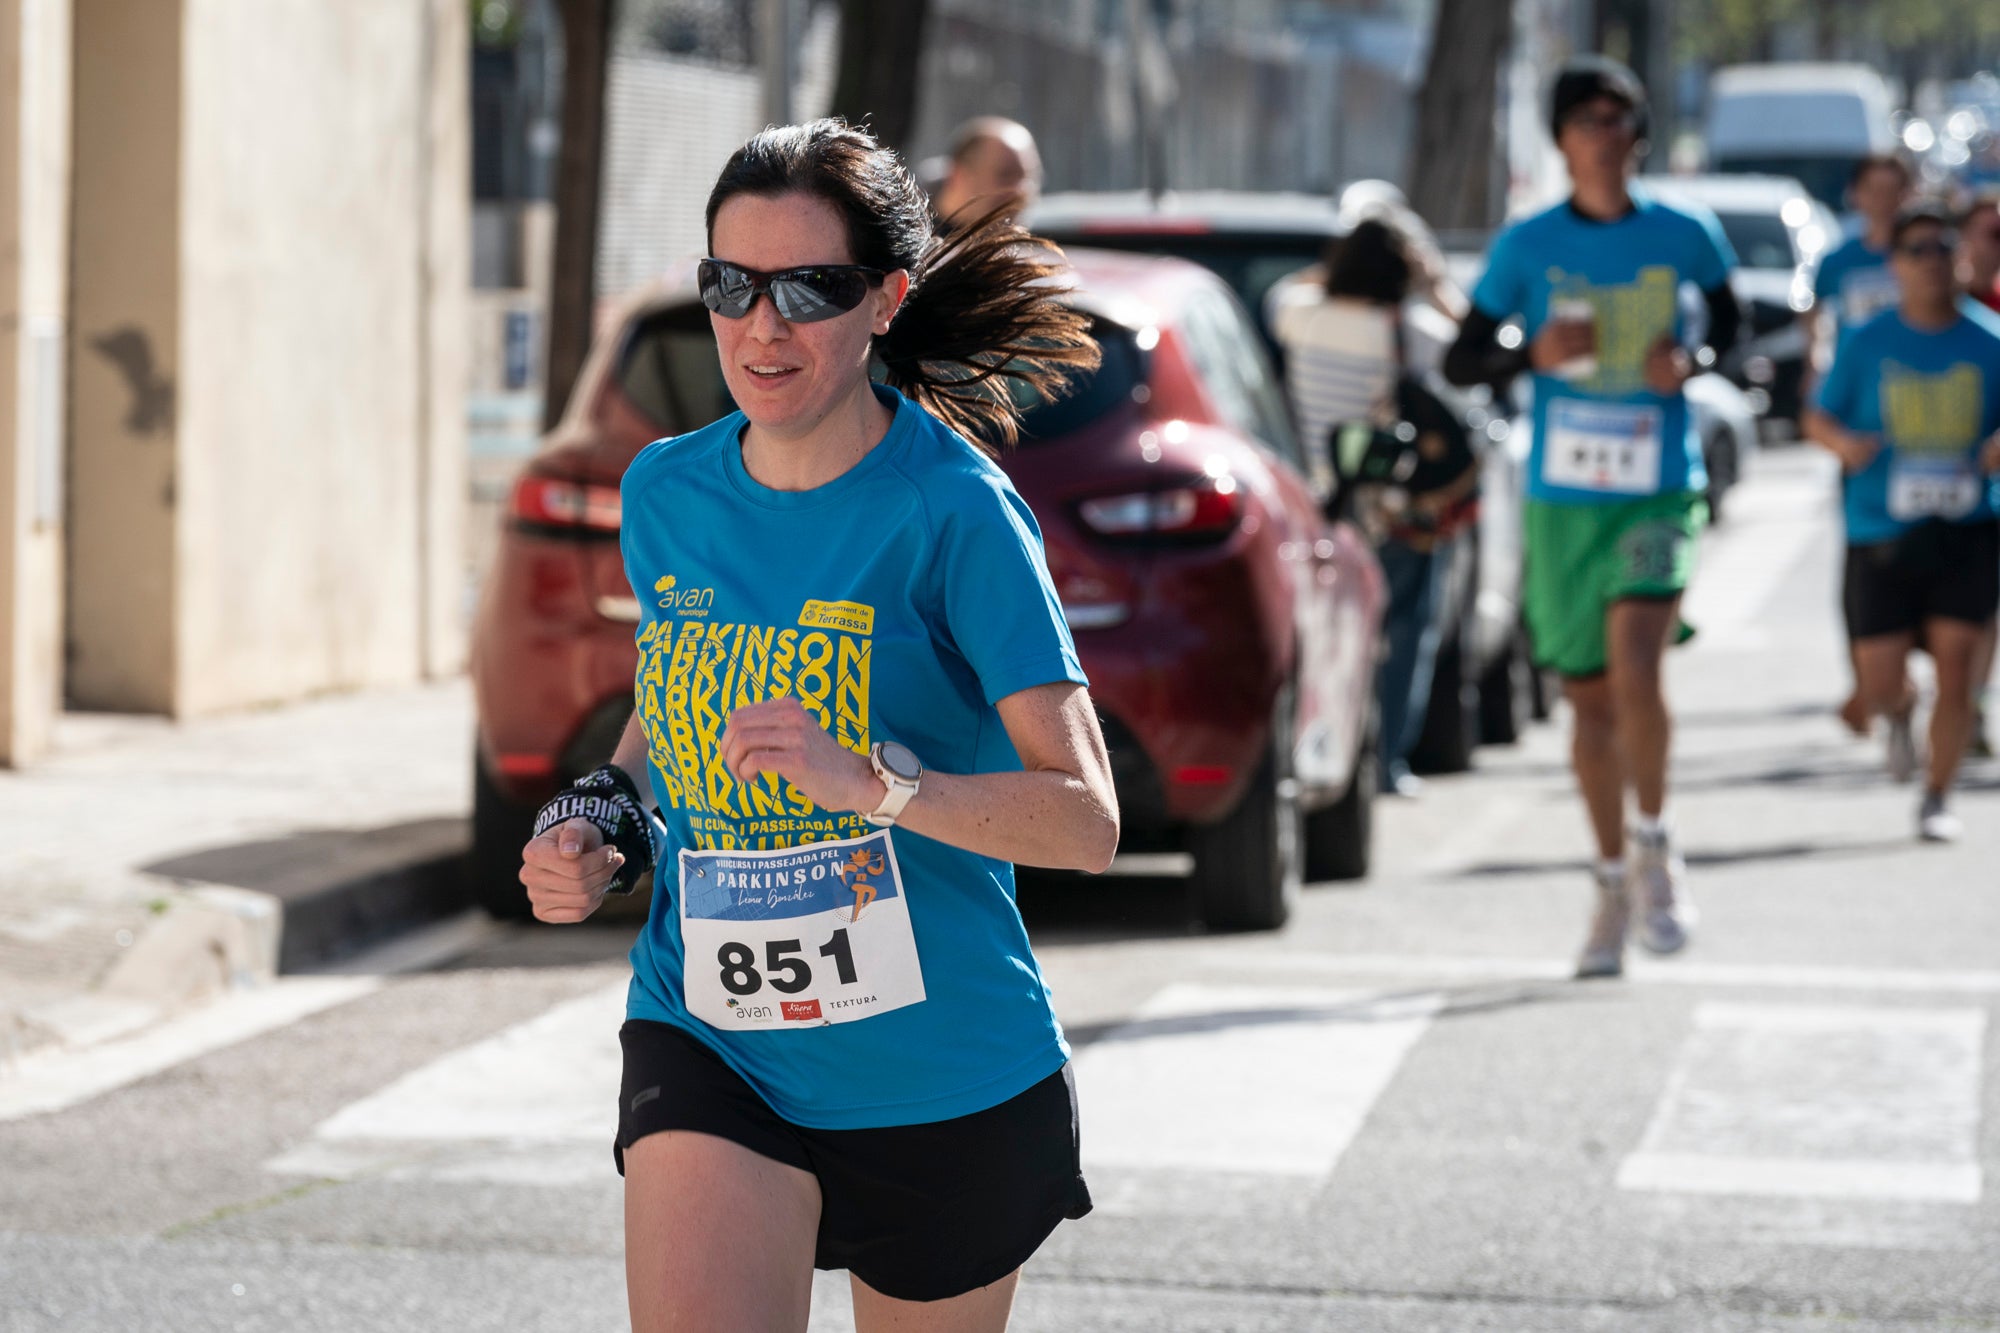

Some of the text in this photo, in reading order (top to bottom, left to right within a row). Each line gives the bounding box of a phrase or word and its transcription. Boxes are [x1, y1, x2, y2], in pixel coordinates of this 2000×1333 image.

[658, 587, 714, 608] avan
[818, 613, 868, 631] Terrassa
[636, 620, 873, 675] PARKINSON
[740, 823, 746, 836] I
[749, 818, 835, 836] PASSEJADA
[838, 814, 866, 829] PEL
[758, 852, 818, 870] PASSEJADA
[820, 849, 840, 860] PEL
[716, 860, 845, 889] PARKINSON
[717, 927, 858, 996] 851
[735, 1006, 772, 1019] avan
[830, 995, 878, 1010] TEXTURA
